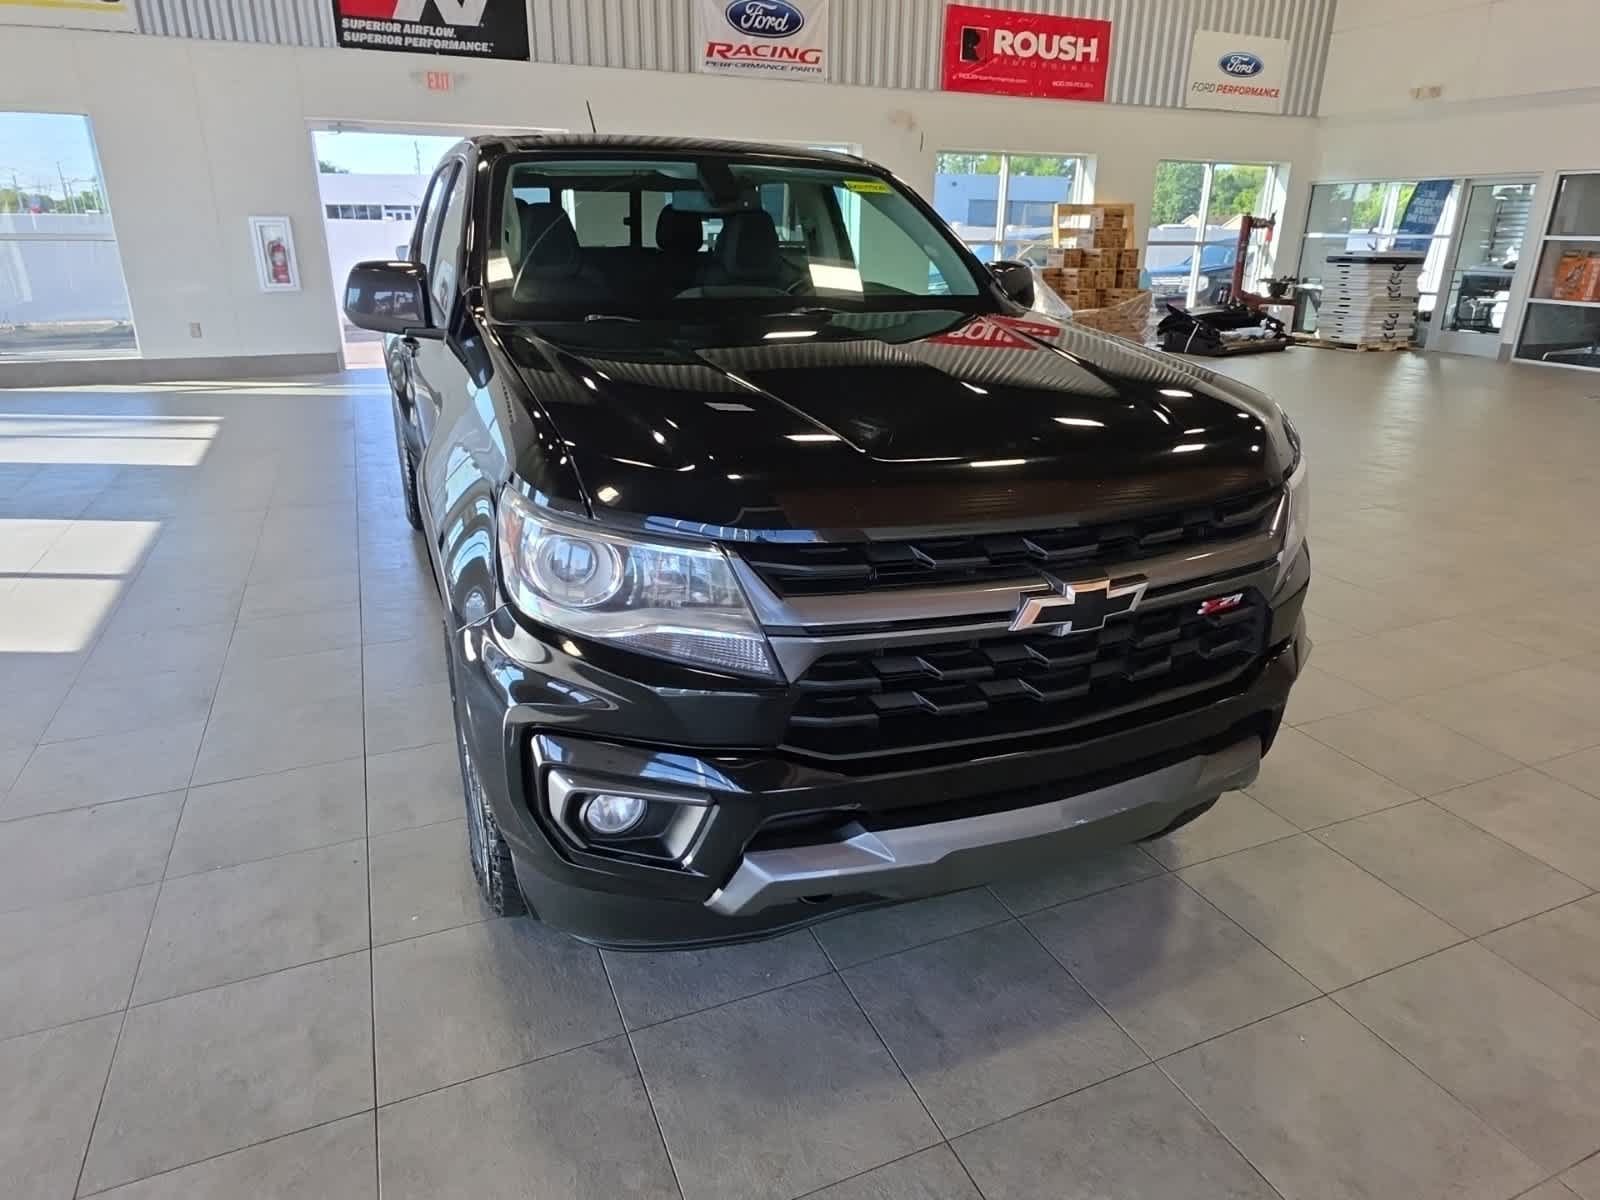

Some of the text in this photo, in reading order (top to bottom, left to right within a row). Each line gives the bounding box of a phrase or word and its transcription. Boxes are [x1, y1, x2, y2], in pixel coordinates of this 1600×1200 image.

[740, 1, 790, 32] Ford
[341, 17, 457, 38] SUPERIOR AIRFLOW.
[342, 31, 403, 46] SUPERIOR
[993, 28, 1099, 63] ROUSH
[706, 41, 823, 65] RACING
[705, 60, 823, 73] PERFORMANCE PARTS
[1226, 55, 1256, 73] Ford
[1192, 81, 1280, 98] FORD PERFORMANCE
